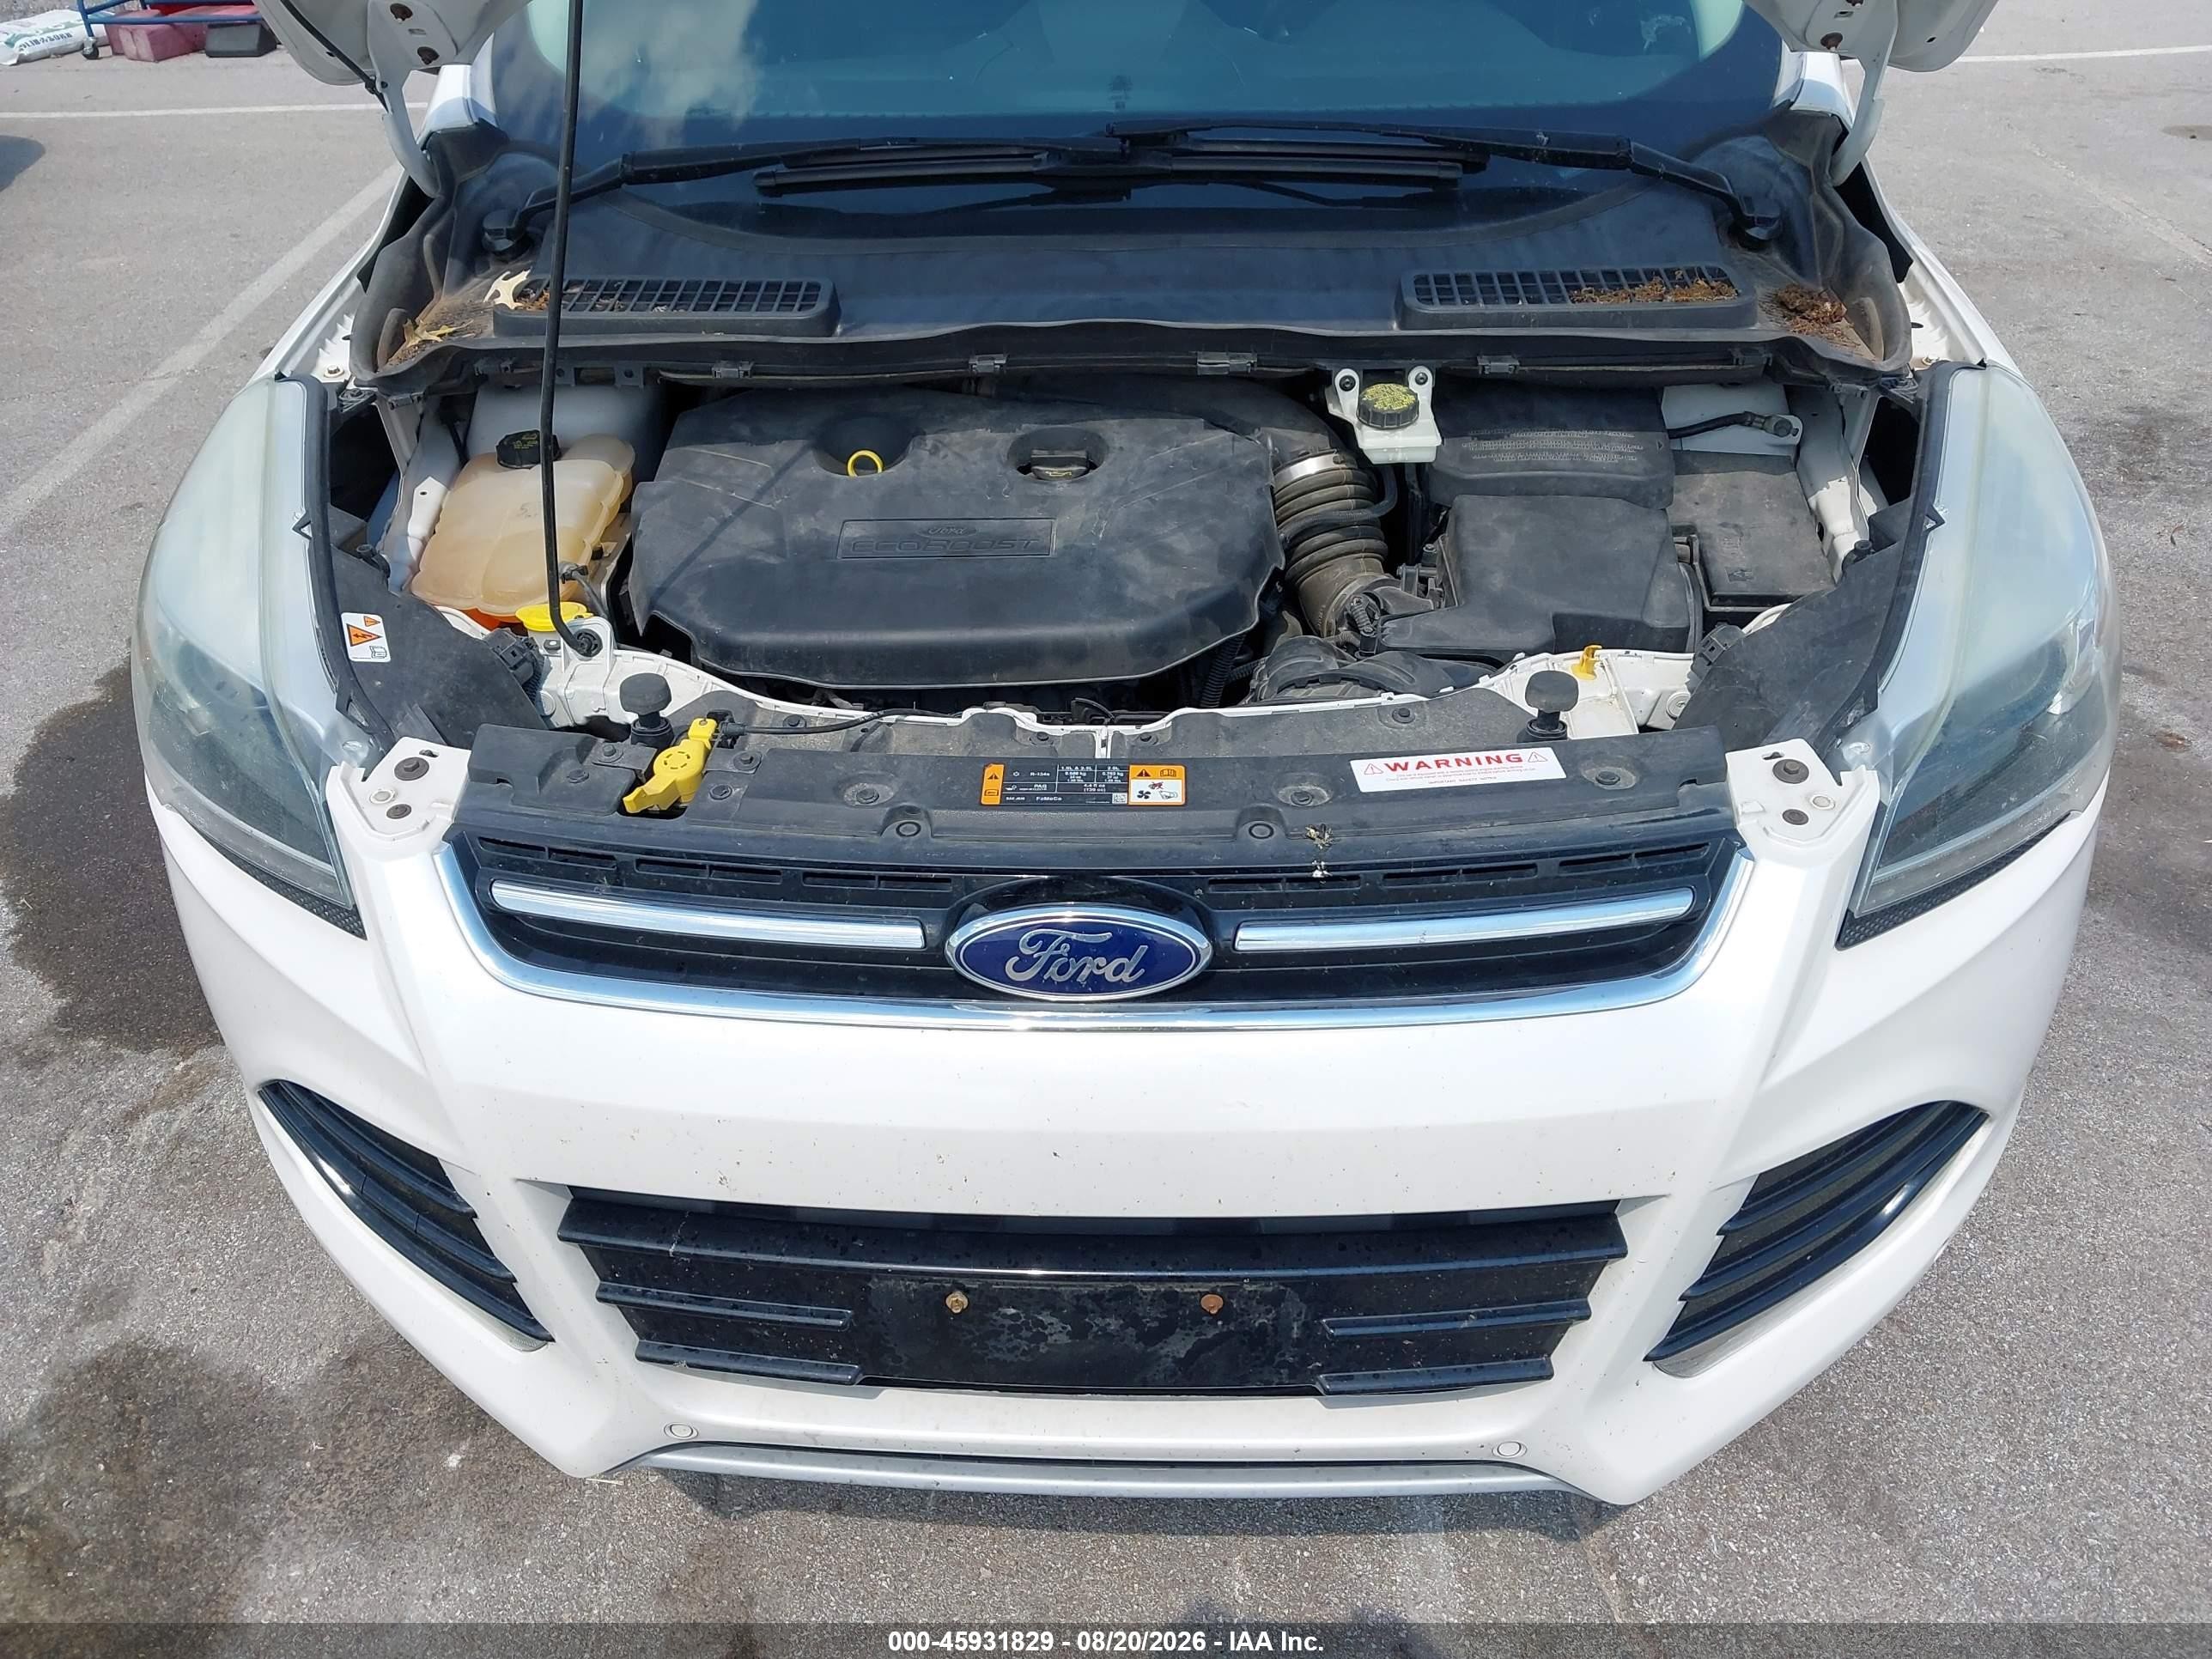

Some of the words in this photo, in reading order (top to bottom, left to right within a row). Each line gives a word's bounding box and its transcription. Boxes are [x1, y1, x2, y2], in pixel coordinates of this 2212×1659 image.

[927, 526, 967, 536] Ford
[1383, 753, 1524, 773] WARNING
[1005, 928, 1149, 983] Ford
